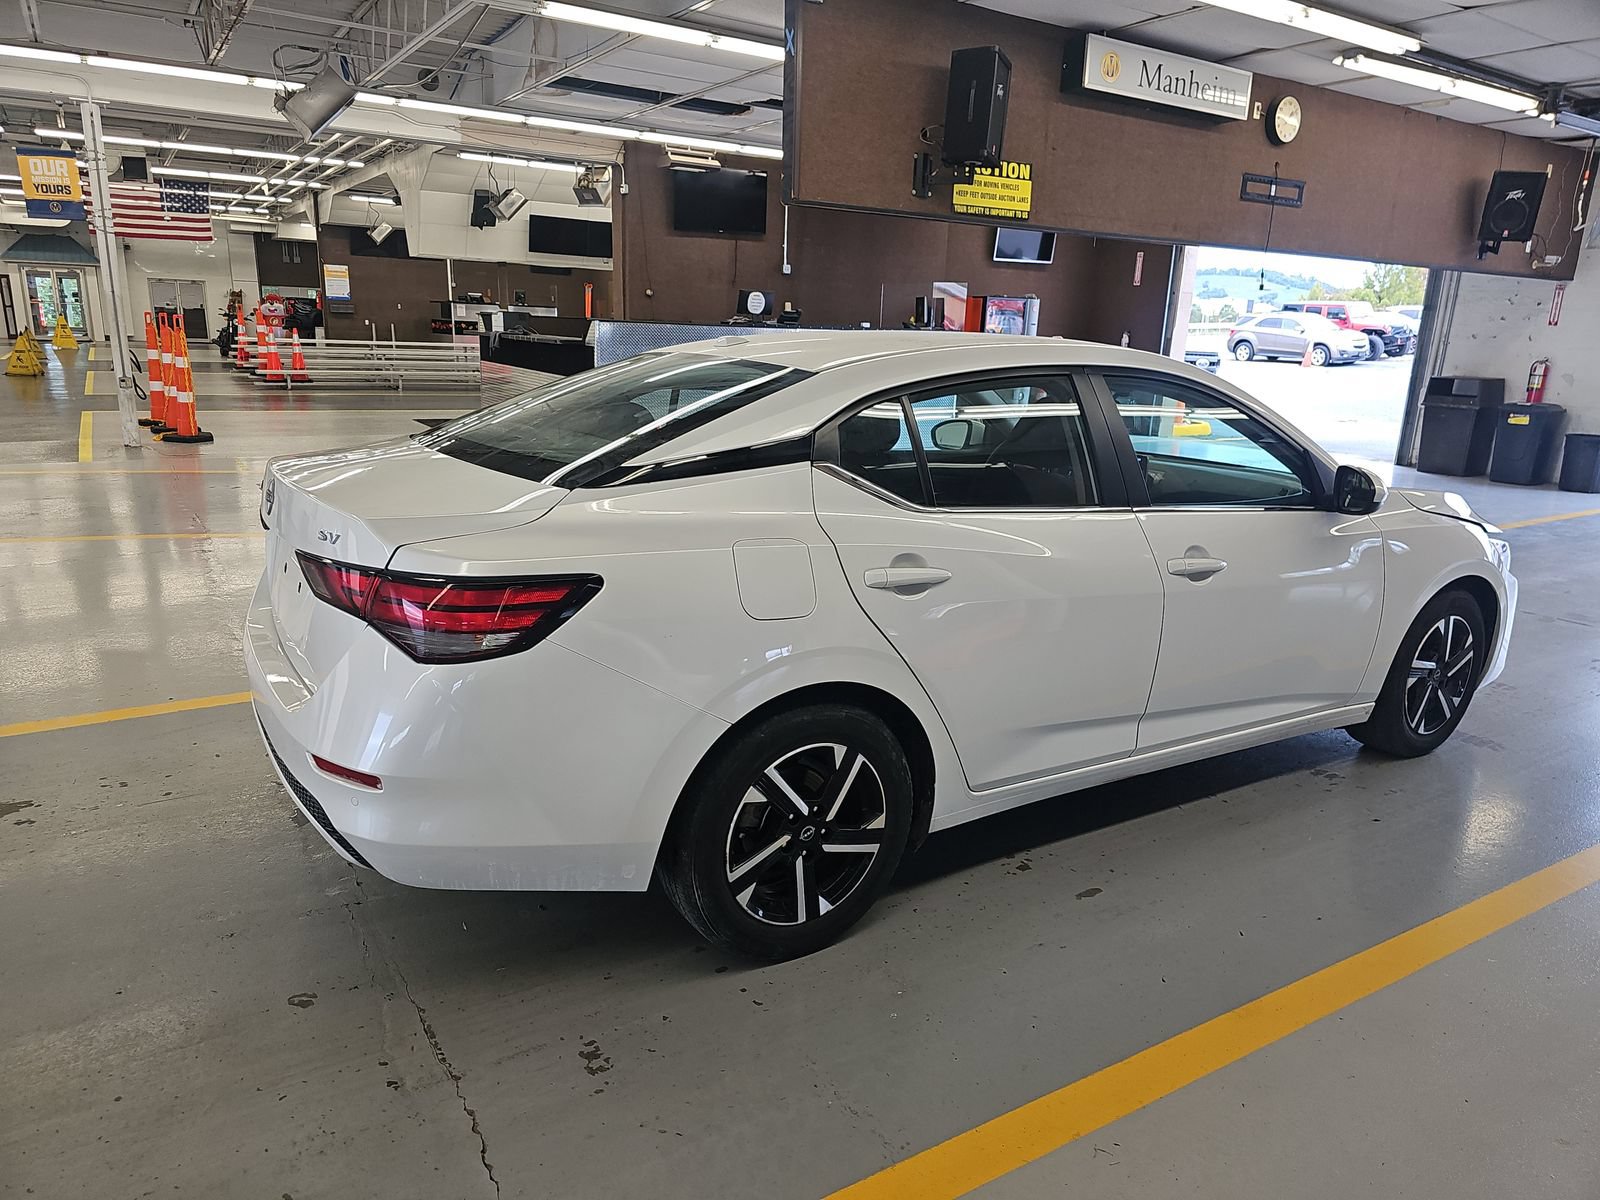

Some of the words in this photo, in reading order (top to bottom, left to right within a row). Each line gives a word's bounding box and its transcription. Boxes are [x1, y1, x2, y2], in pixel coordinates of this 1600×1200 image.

[1137, 59, 1236, 104] Manheim
[28, 158, 68, 177] OUR
[31, 175, 62, 184] MISSION
[63, 177, 70, 185] IS
[983, 181, 1000, 190] MOVING
[1000, 182, 1020, 191] VEHICLES
[33, 183, 72, 195] YOURS
[969, 191, 980, 199] FEET
[980, 192, 998, 201] OUTSIDE
[998, 194, 1016, 202] AUCTION
[1016, 196, 1029, 204] LANES
[954, 204, 967, 213] YOUR
[967, 205, 984, 215] SAFETY
[984, 207, 990, 215] IS
[990, 208, 1015, 218] IMPORTANT
[1015, 210, 1022, 218] TO
[1022, 211, 1028, 219] US
[317, 529, 342, 545] SV
